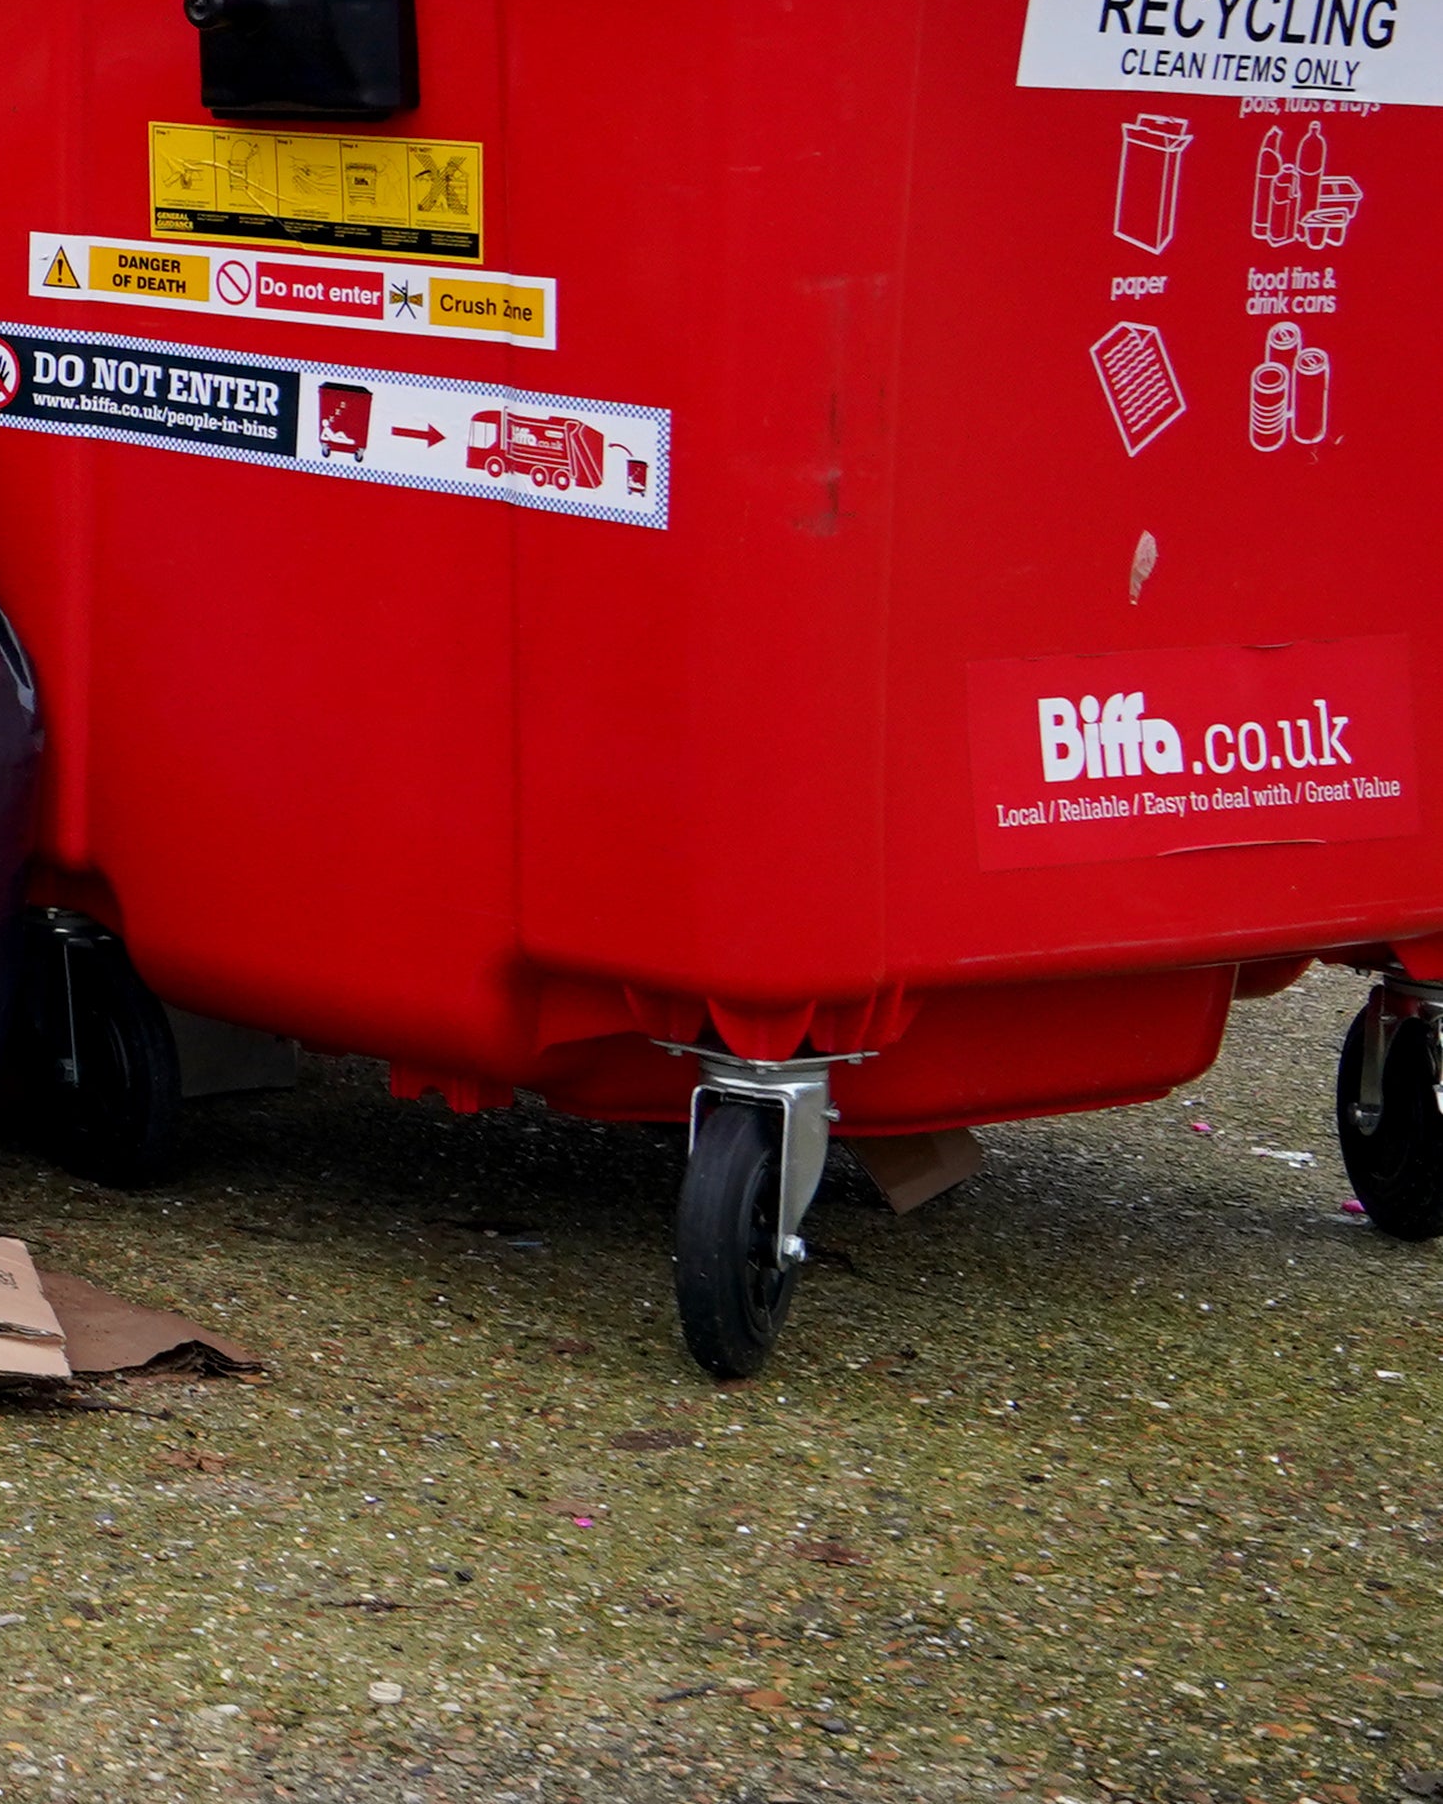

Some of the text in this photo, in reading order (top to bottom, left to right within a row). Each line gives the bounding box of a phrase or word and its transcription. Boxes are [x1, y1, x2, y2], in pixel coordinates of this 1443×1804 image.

[1121, 47, 1361, 88] CLEAN ITEMS ONLY
[156, 211, 188, 221] GENERAL
[156, 220, 193, 231] GUIDANCE
[118, 254, 182, 275] DANGER
[111, 272, 186, 295] OF DEATH
[259, 274, 382, 307] Do not enter
[1111, 275, 1168, 301] paper
[1248, 267, 1336, 290] food tins &
[439, 293, 497, 317] Crush
[1246, 294, 1336, 315] drink cans
[33, 350, 280, 416] DO NOT ENTER
[32, 391, 278, 441] www.biffa.co.uk/people-in-bins
[997, 802, 1046, 828] Local
[1059, 795, 1129, 823] Reliable
[1143, 792, 1187, 818] Easy
[1191, 791, 1209, 812] to
[1212, 786, 1250, 811] deal
[1253, 783, 1292, 808] with
[1305, 779, 1351, 803] Great
[1355, 776, 1401, 800] Value
